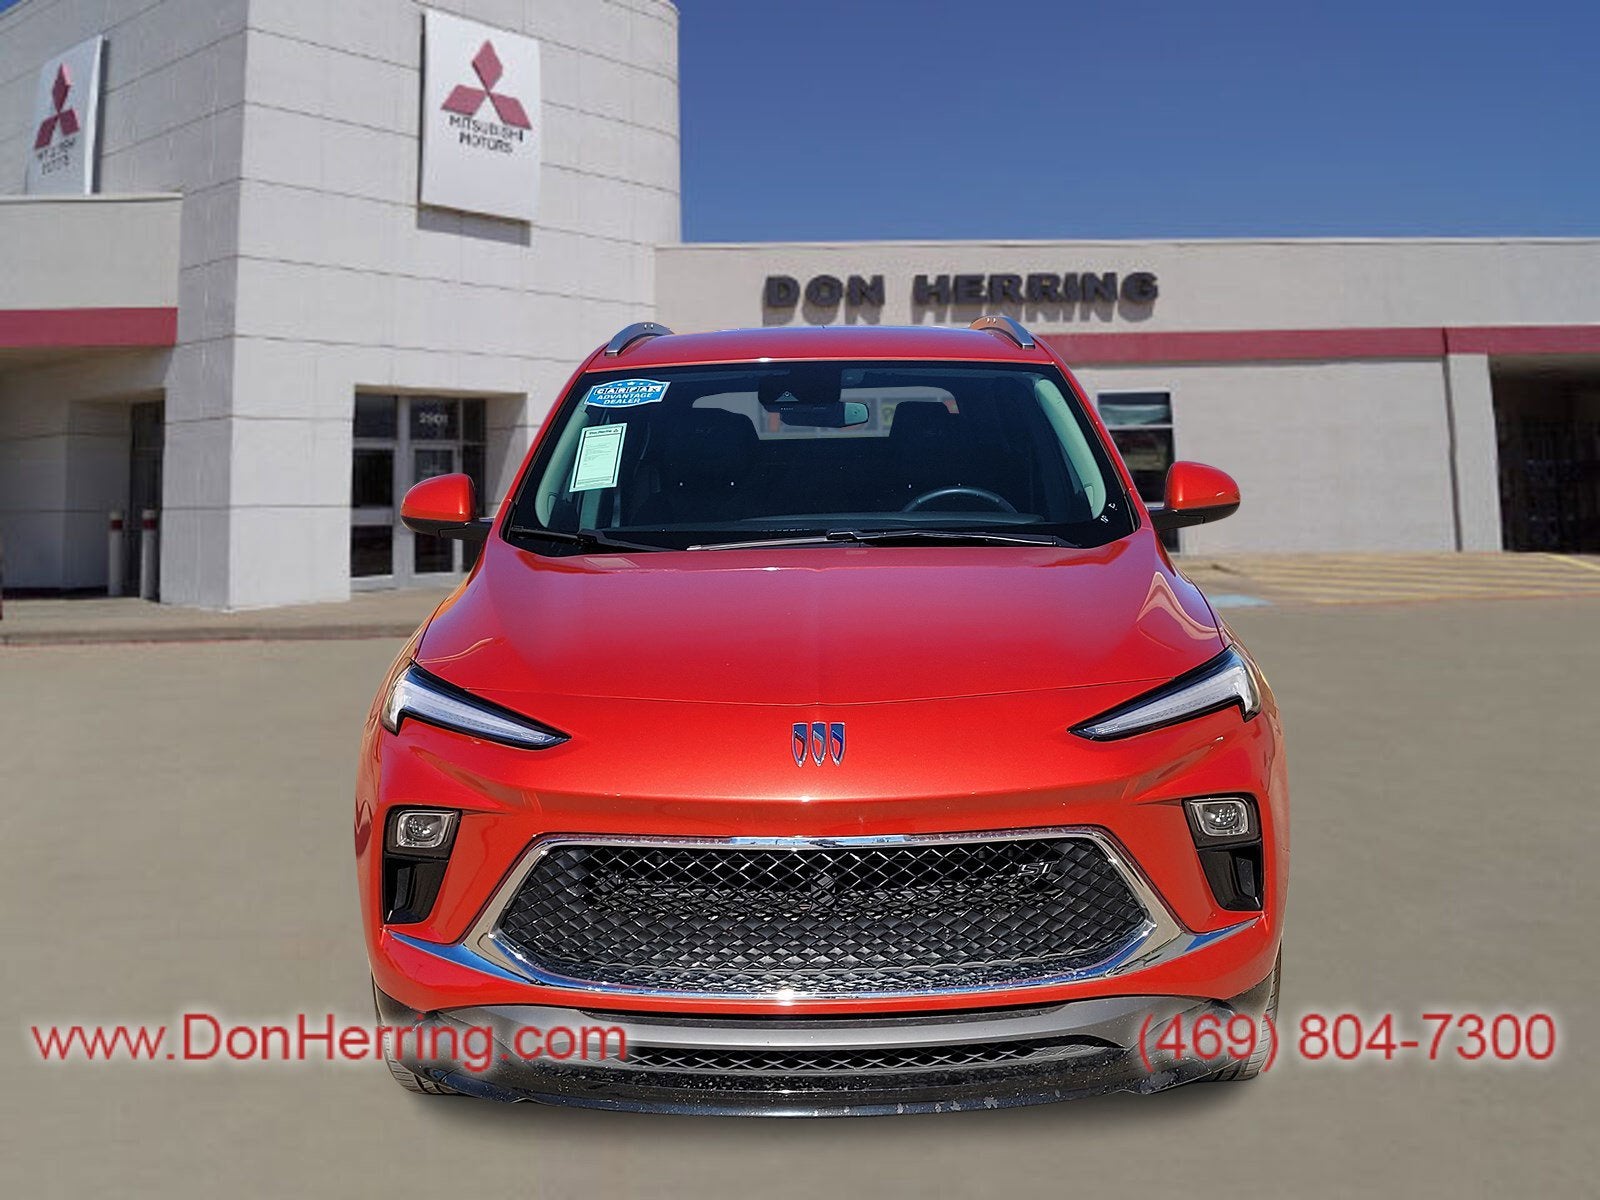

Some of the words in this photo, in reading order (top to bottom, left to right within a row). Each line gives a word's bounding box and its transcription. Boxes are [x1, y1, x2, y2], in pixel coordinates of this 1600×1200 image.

[449, 115, 524, 142] MITSUBISHI
[459, 131, 514, 154] MOTORS
[764, 274, 886, 307] DON
[913, 272, 1158, 305] HERRING
[597, 392, 653, 401] ADVANTAGE
